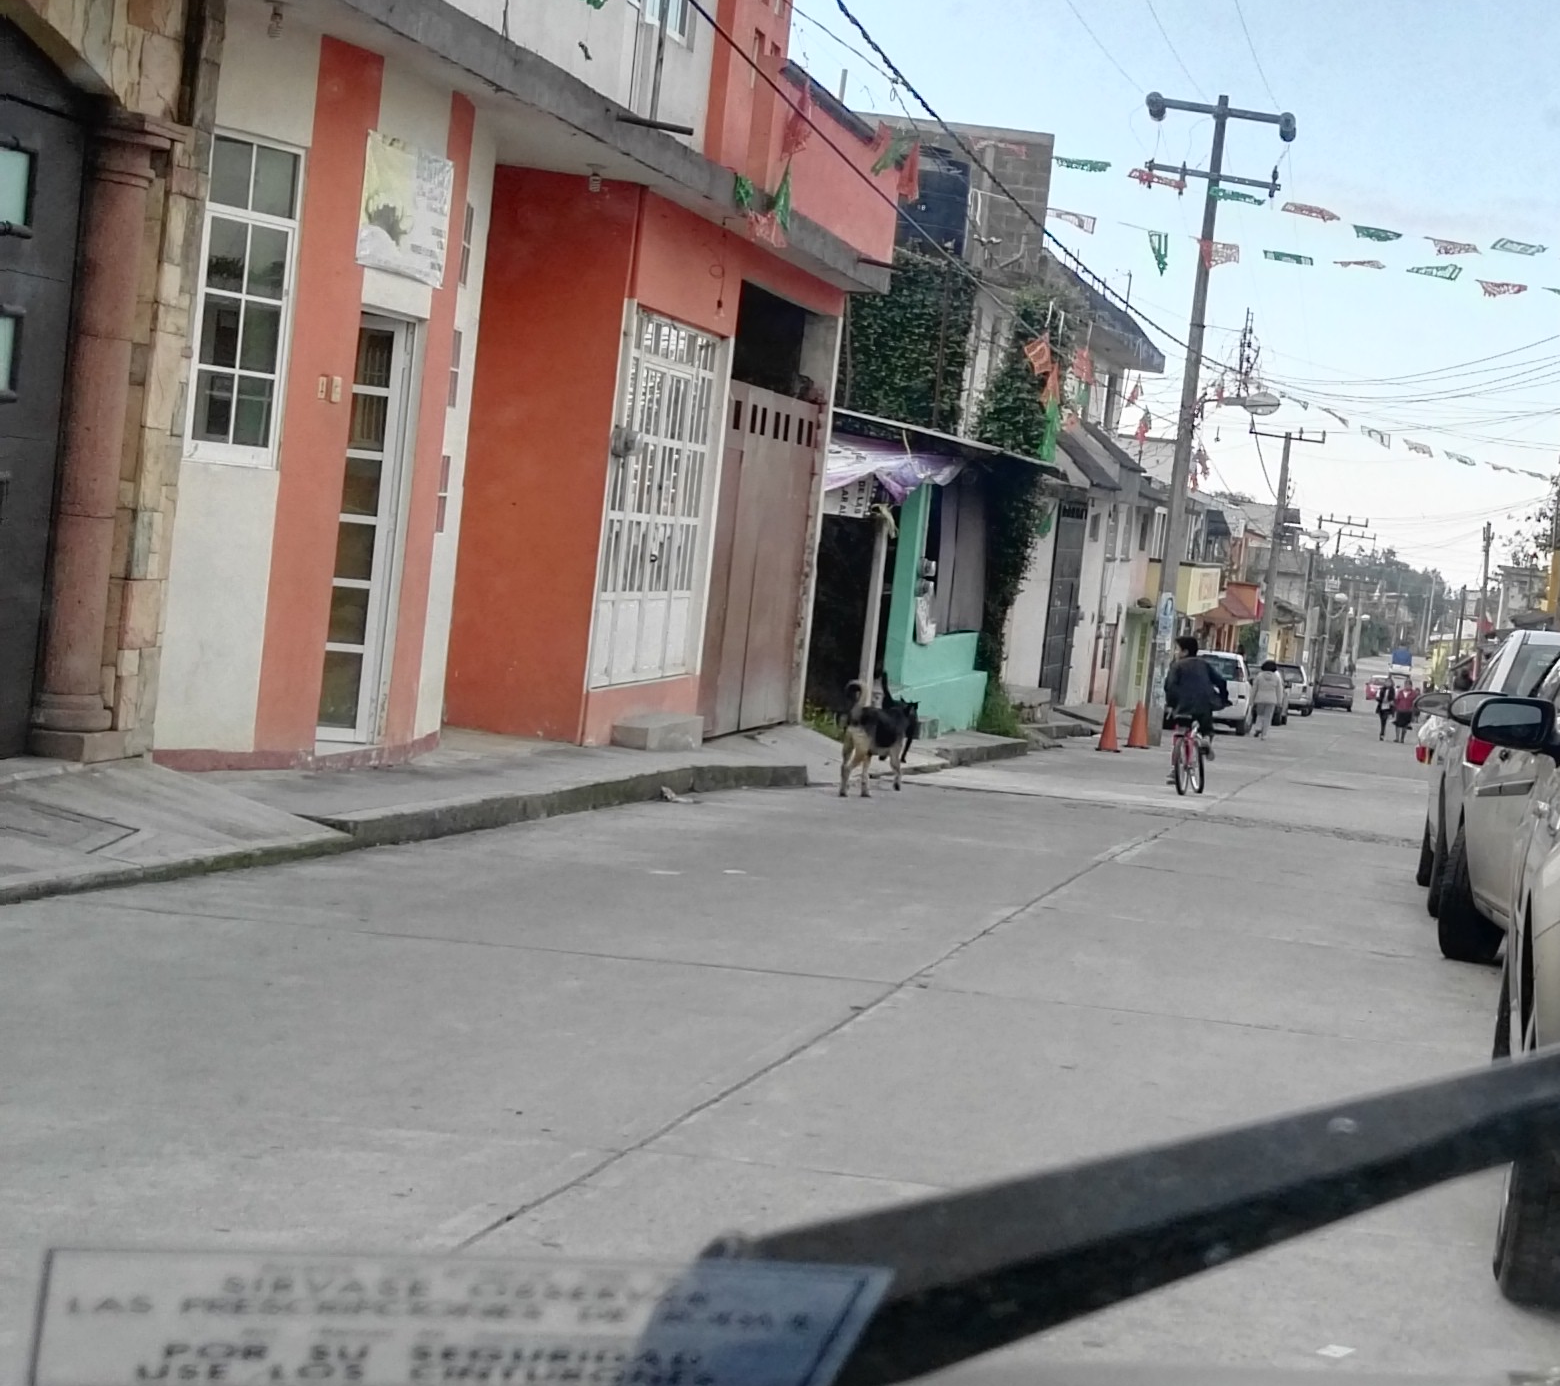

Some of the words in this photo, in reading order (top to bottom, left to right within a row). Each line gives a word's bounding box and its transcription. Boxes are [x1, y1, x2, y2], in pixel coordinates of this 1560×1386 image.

[162, 1343, 269, 1361] POR
[136, 1363, 230, 1381] USE
[268, 1364, 365, 1382] LOS
